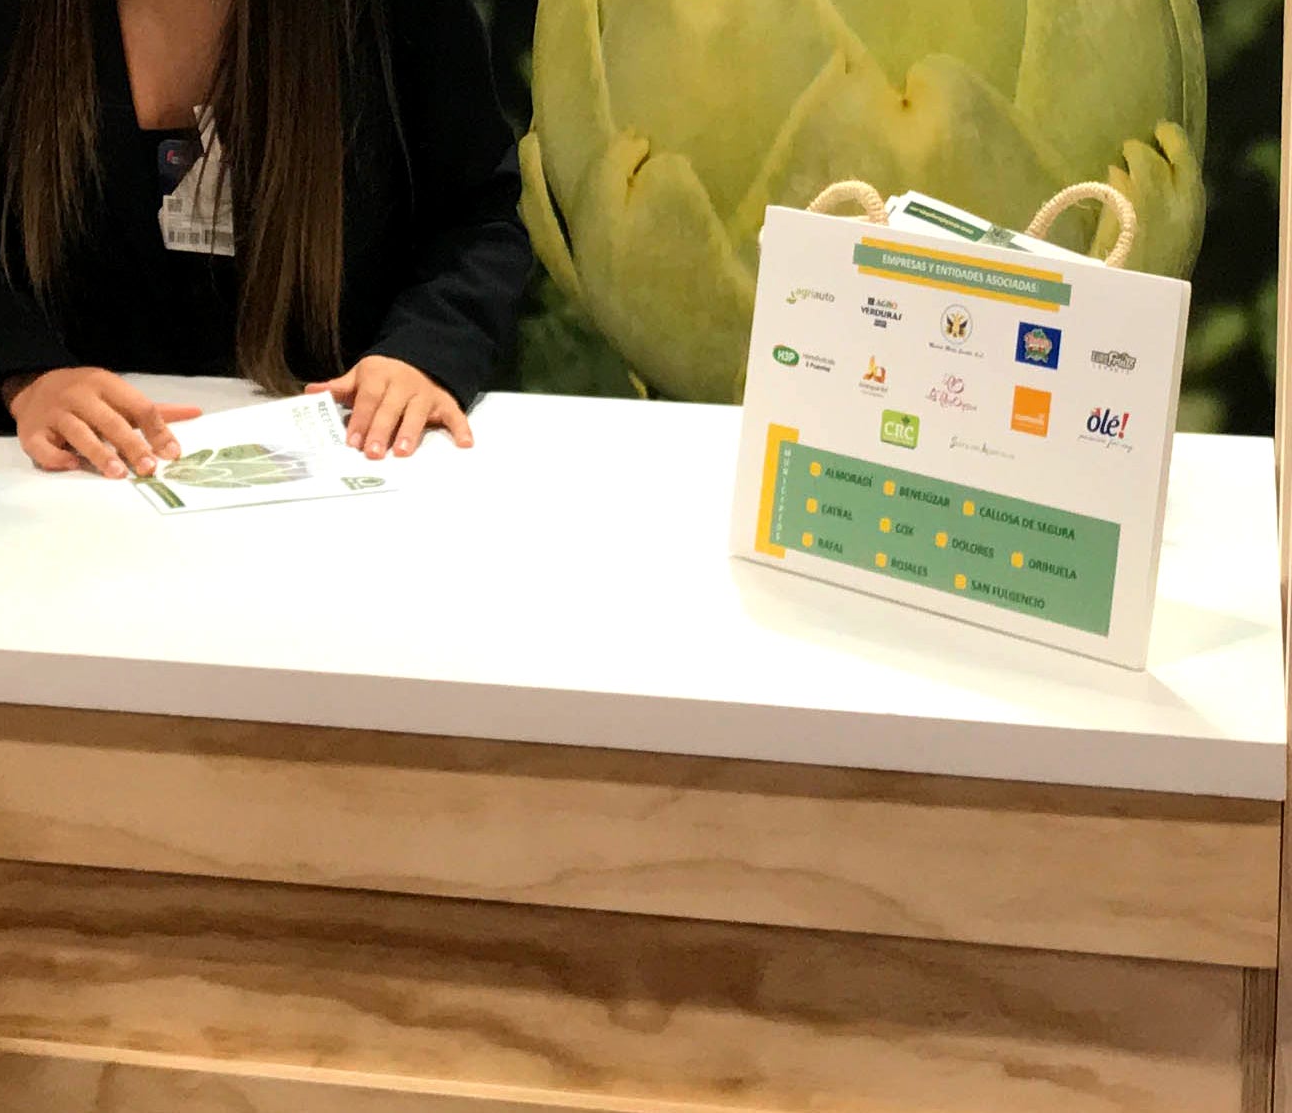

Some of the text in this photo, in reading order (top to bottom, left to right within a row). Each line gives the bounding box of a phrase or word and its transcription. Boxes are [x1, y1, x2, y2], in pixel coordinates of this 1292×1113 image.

[882, 253, 927, 272] EMPRESAS
[928, 262, 935, 272] Y
[935, 265, 983, 284] ENTIDADES
[884, 421, 915, 441] CRC
[821, 504, 853, 521] CATRAL
[895, 523, 915, 536] COX
[979, 506, 1076, 541] CALLOSA DE SEGURA
[818, 537, 844, 554] RAFAL
[951, 538, 995, 559] DOLORES
[890, 558, 928, 577] ROJALES
[1028, 558, 1077, 580] ORIHUELA
[971, 580, 1045, 609] SAN FULGENCIO
